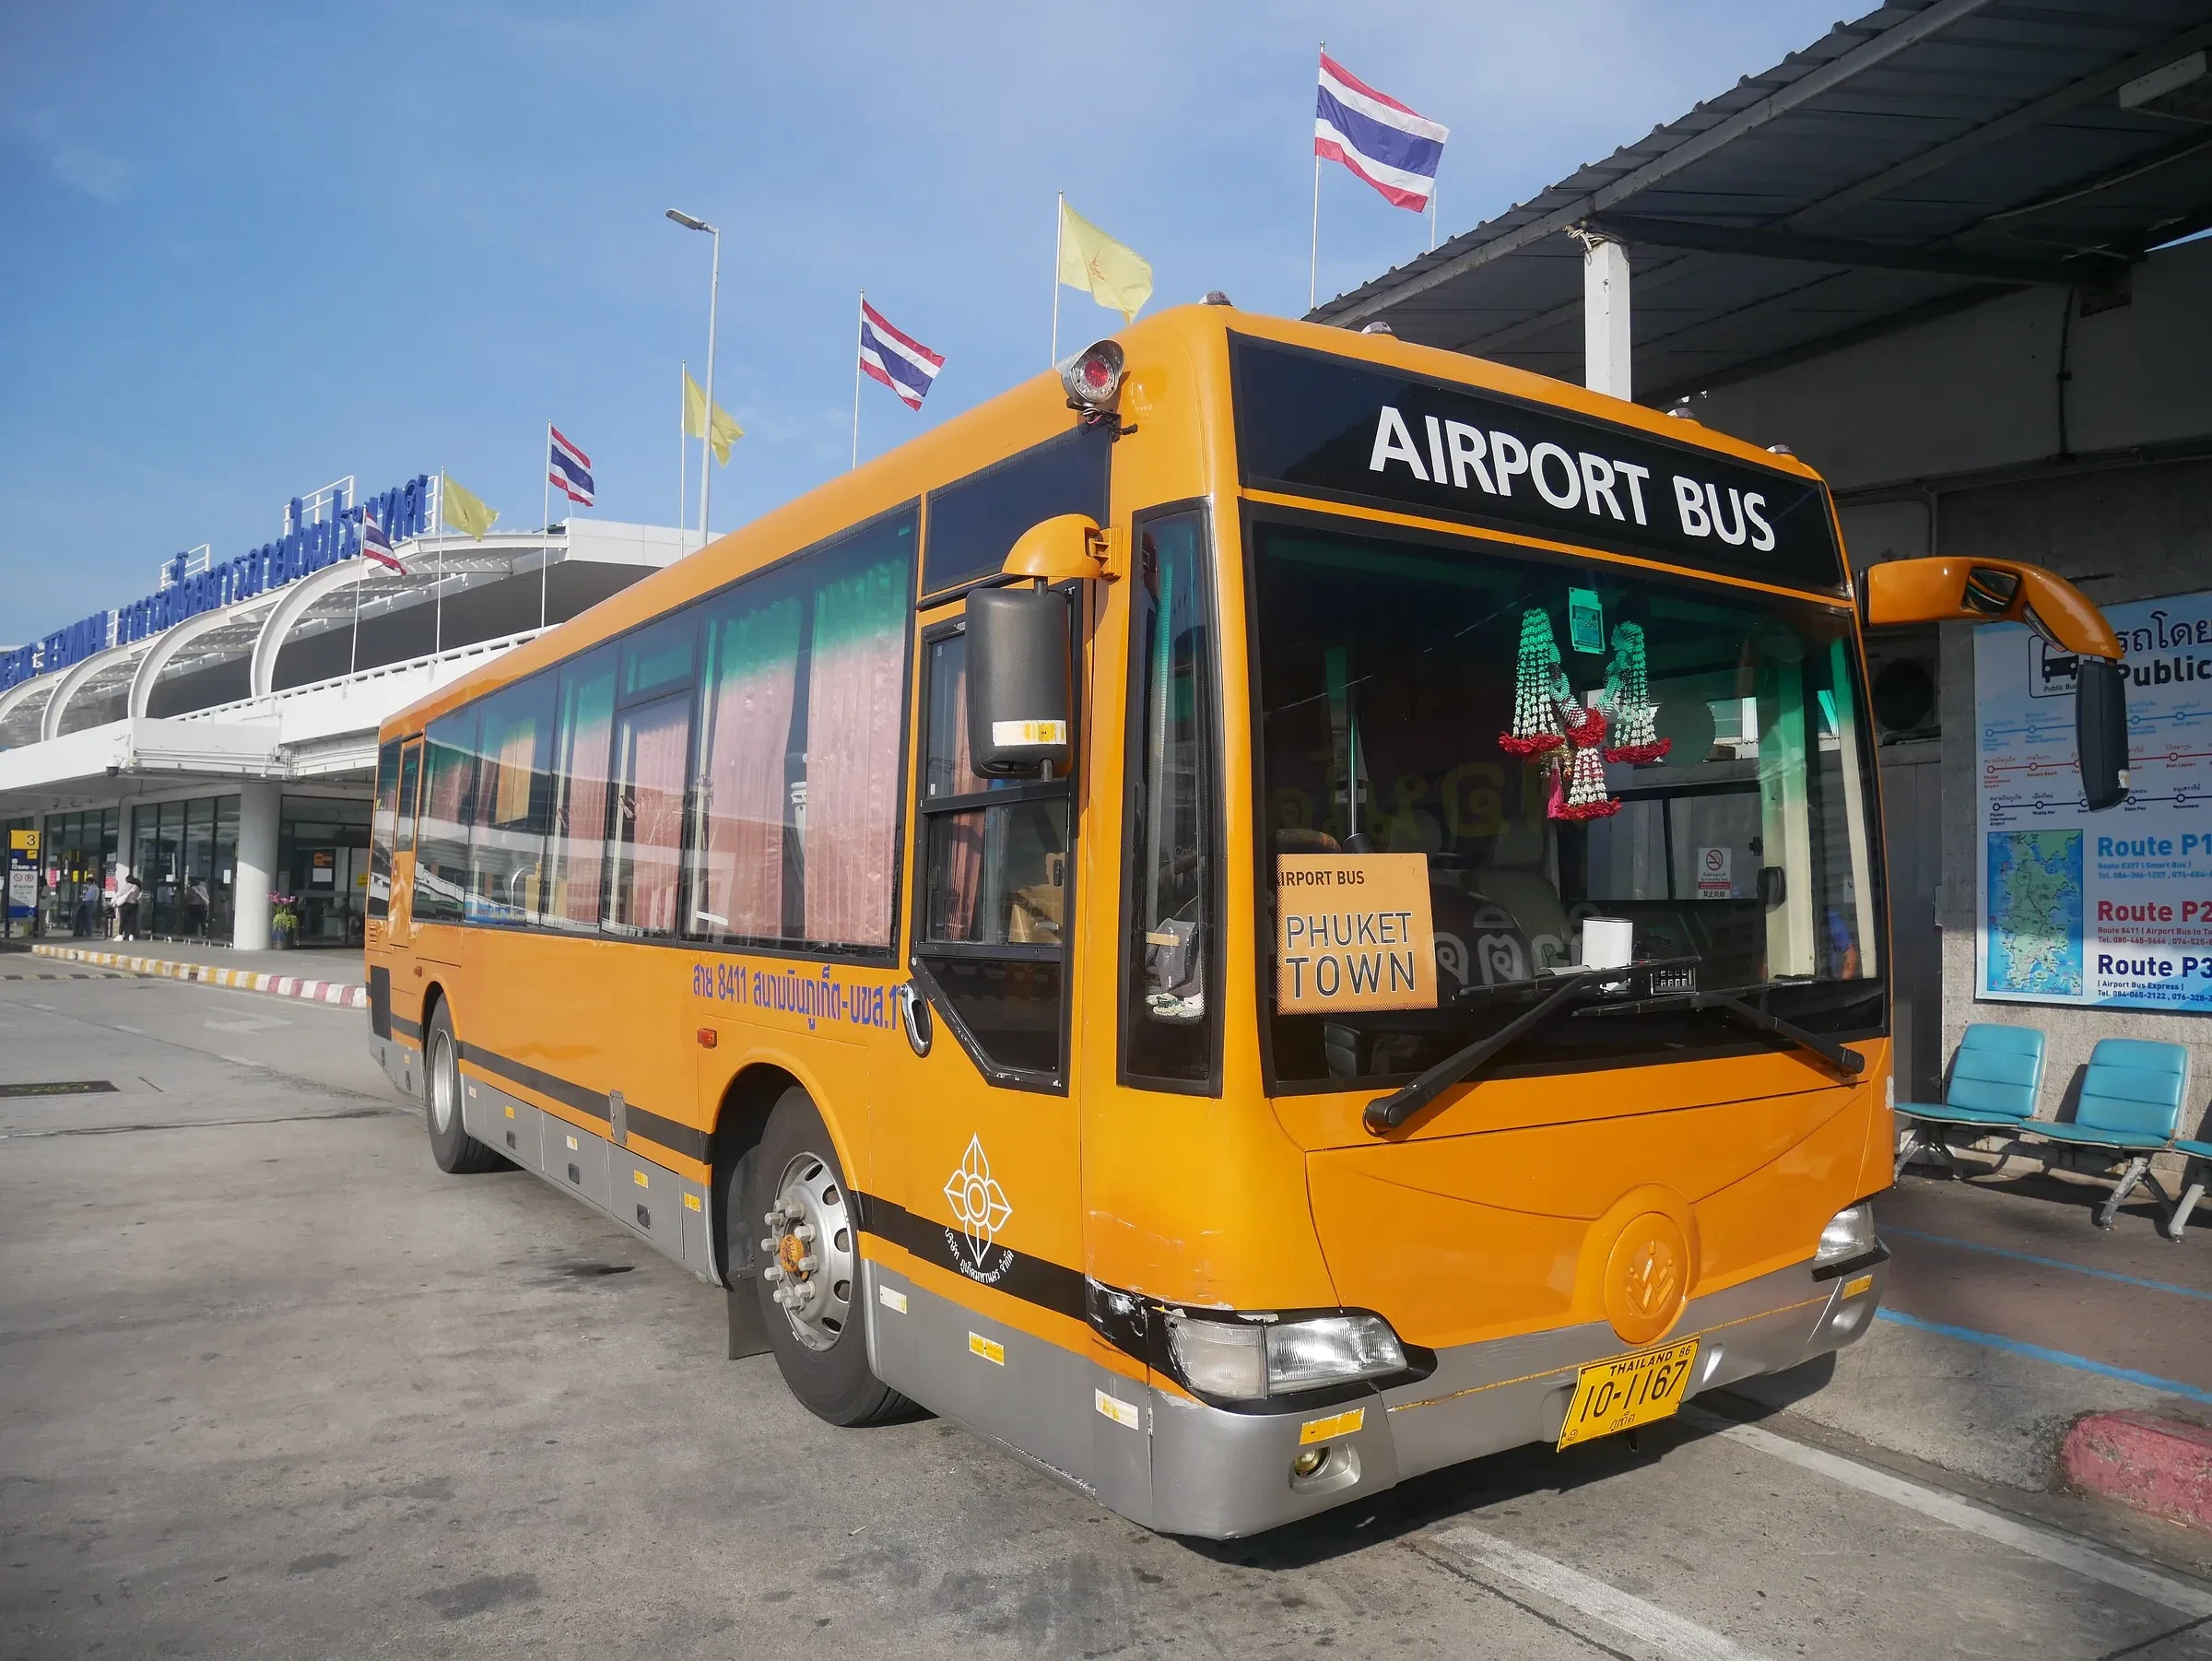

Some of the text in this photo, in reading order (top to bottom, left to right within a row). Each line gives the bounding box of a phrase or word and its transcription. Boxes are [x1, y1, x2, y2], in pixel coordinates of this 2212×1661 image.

[1370, 406, 1775, 551] AIRPORT BUS
[2043, 684, 2064, 692] Public
[27, 834, 35, 845] 3
[2098, 833, 2212, 857] Route P1
[1281, 870, 1365, 886] IRPORT BUS
[2098, 901, 2212, 922] Route P2
[1286, 912, 1413, 949] PHUKET
[2147, 927, 2174, 936] Airport
[1285, 950, 1416, 999] TOWN
[2098, 954, 2212, 978] Route P3
[693, 963, 713, 997] สาย
[718, 963, 747, 1004] 8411
[2112, 991, 2166, 999] 084-065-2122
[1609, 1345, 1691, 1377] THAILAND 86
[1580, 1360, 1688, 1423] 10-1167
[1608, 1410, 1636, 1431] ภูเก็ต
